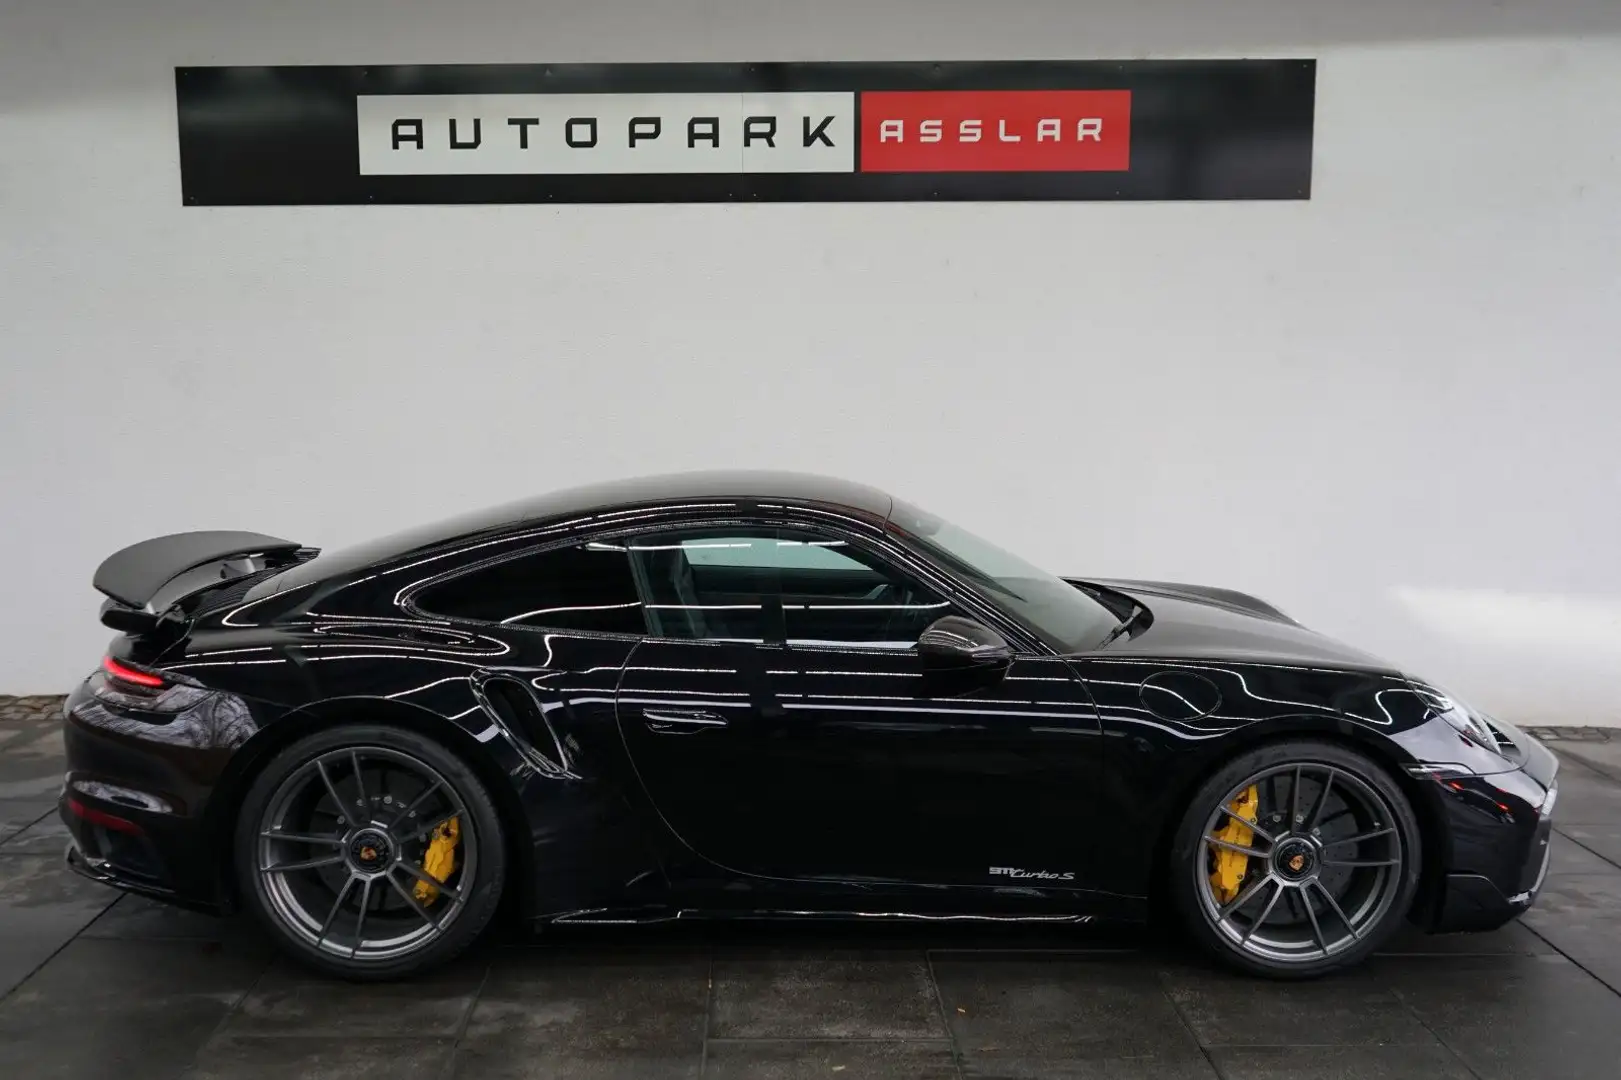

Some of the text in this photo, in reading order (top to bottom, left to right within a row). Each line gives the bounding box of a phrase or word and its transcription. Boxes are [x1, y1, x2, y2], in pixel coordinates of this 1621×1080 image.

[391, 116, 1102, 150] AUTOPARK ASSLAR
[1058, 872, 1076, 880] S
